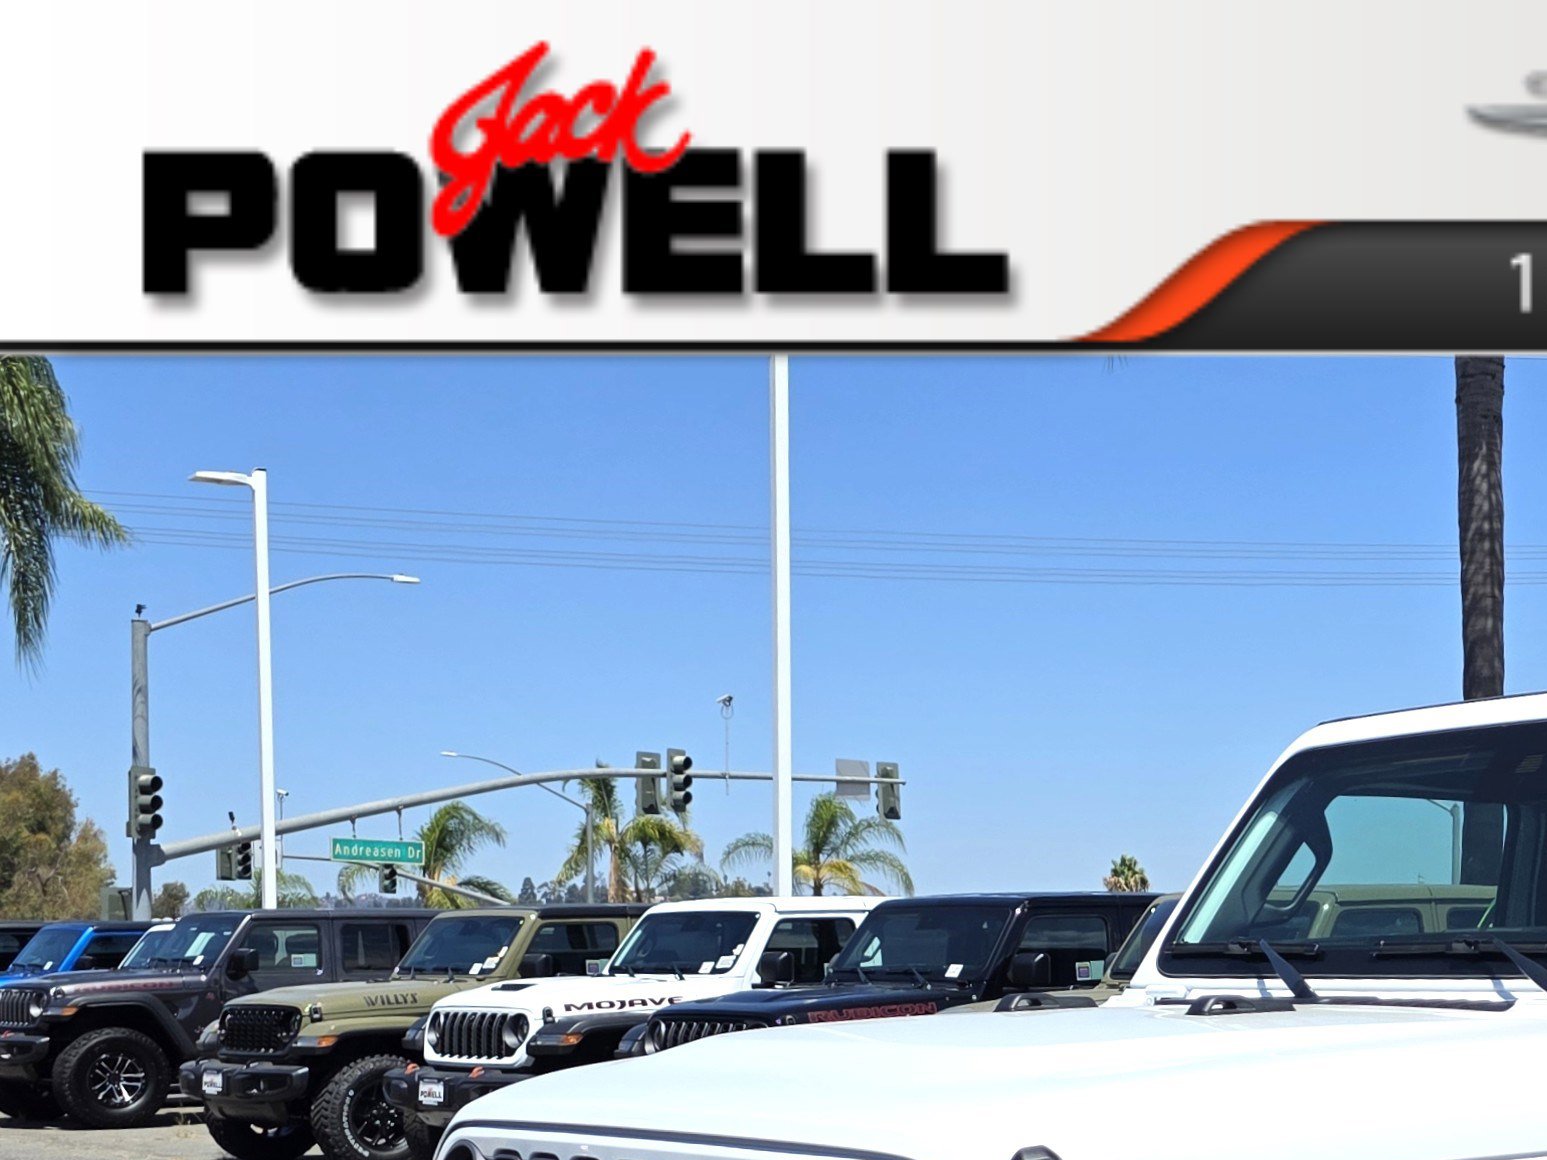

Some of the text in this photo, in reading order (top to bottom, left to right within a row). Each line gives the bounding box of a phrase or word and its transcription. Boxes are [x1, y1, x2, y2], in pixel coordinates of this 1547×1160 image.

[334, 843, 421, 859] Andreasen Dr
[363, 992, 418, 1007] WILLYS
[564, 996, 683, 1012] MOJAVE
[807, 1002, 938, 1023] RUBICON
